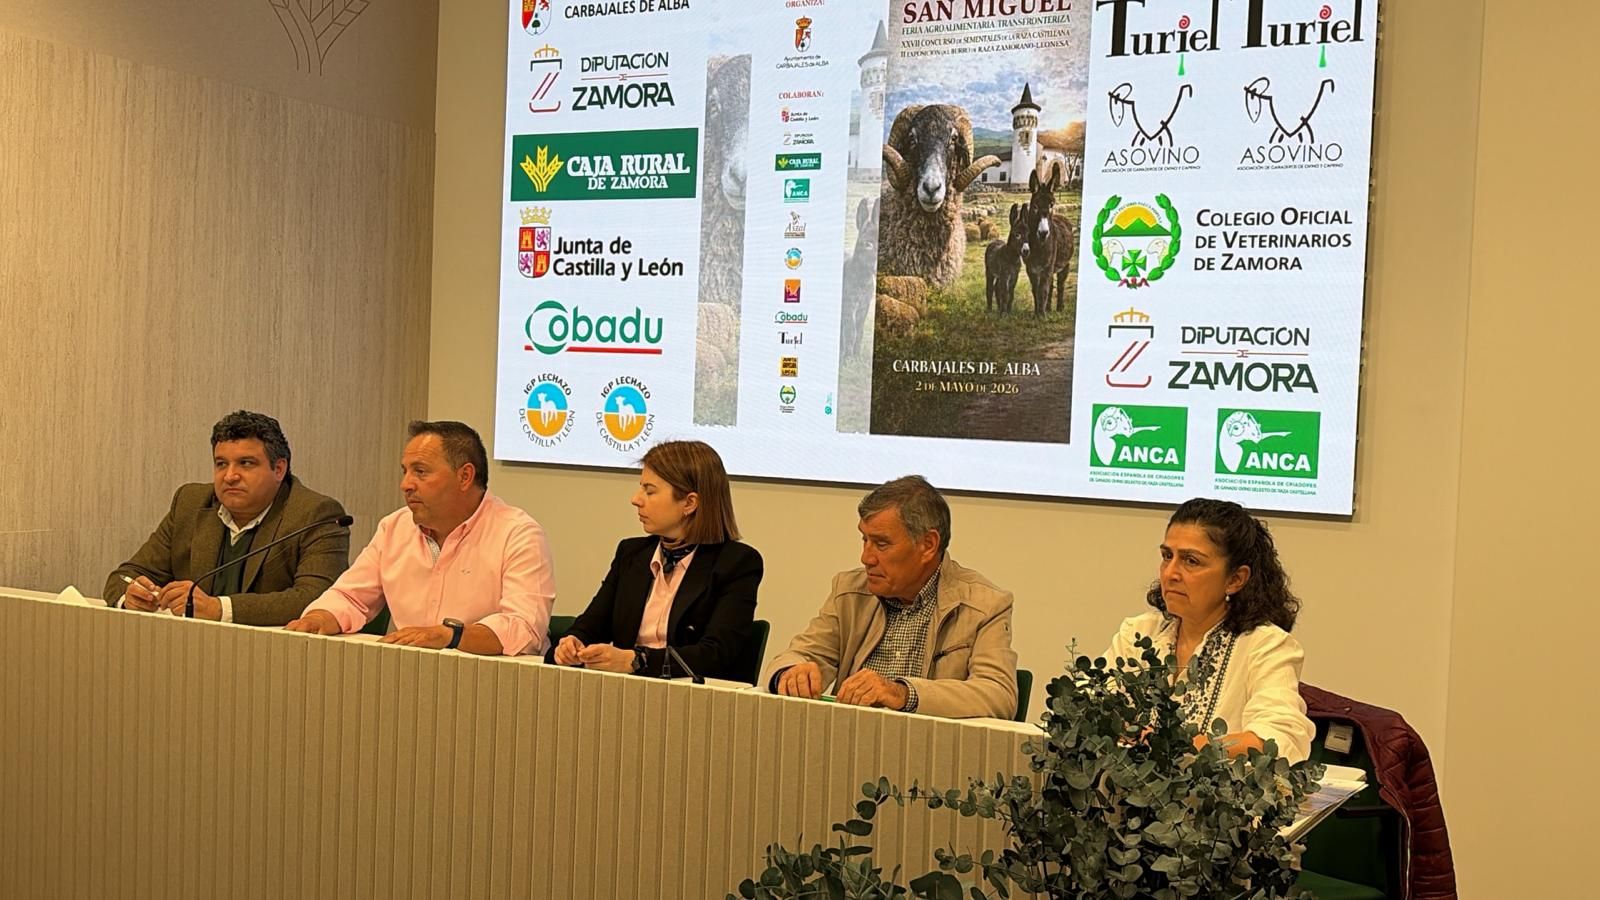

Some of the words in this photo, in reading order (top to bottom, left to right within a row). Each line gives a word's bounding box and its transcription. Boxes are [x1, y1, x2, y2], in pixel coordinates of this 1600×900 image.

[564, 0, 636, 19] CARBAJALES
[639, 0, 655, 13] DE
[658, 0, 690, 11] ALBA
[903, 0, 952, 24] SAN
[963, 0, 1072, 19] MIGUEL
[902, 26, 923, 35] FERIA
[924, 20, 995, 34] AGROALIMENTARIA
[998, 14, 1071, 28] TRANSFRONTERIZA
[1096, 0, 1220, 57] Turiel
[1241, 0, 1364, 48] Turiel
[921, 38, 956, 47] CONCURSO
[963, 34, 1002, 44] SEMENTALES
[1032, 30, 1070, 38] CASTELLANA
[572, 82, 675, 111] ZAMORA
[779, 90, 824, 100] COLABORAN:
[1104, 146, 1200, 167] ASOVINO
[1240, 143, 1342, 164] ASOVINO
[567, 156, 616, 177] CAJA
[620, 153, 690, 175] RURAL
[587, 177, 606, 190] DE
[610, 175, 668, 189] ZAMORA
[1196, 209, 1275, 227] COLEGIO
[1280, 207, 1353, 225] OFICIAL
[553, 237, 603, 255] Junta
[609, 237, 631, 254] de
[1195, 235, 1217, 248] DE
[1222, 231, 1352, 248] VETERINARIOS
[553, 258, 615, 276] Castilla
[620, 262, 632, 281] y
[638, 258, 683, 276] León
[1194, 258, 1215, 271] DE
[1220, 253, 1302, 271] ZAMORA
[525, 300, 663, 355] Cobadu
[892, 359, 975, 376] CARBAJALES
[979, 362, 998, 375] DE
[1004, 362, 1041, 377] ALBA
[1168, 361, 1319, 393] ZAMORA
[524, 378, 536, 395] IGP
[538, 373, 572, 396] LECHAZO
[601, 381, 614, 398] IGP
[615, 376, 651, 399] LECHAZO
[915, 382, 922, 391] 2
[924, 382, 935, 391] DE
[939, 382, 974, 393] MAYO
[976, 384, 987, 393] DE
[990, 382, 1019, 394] 2026
[519, 408, 526, 423] DE
[522, 423, 556, 447] CASTILLA
[556, 434, 562, 442] Y
[596, 412, 603, 427] DE
[600, 428, 635, 452] CASTILLA
[634, 439, 641, 447] Y
[1118, 445, 1179, 465] ANCA
[1245, 452, 1311, 472] ANCA
